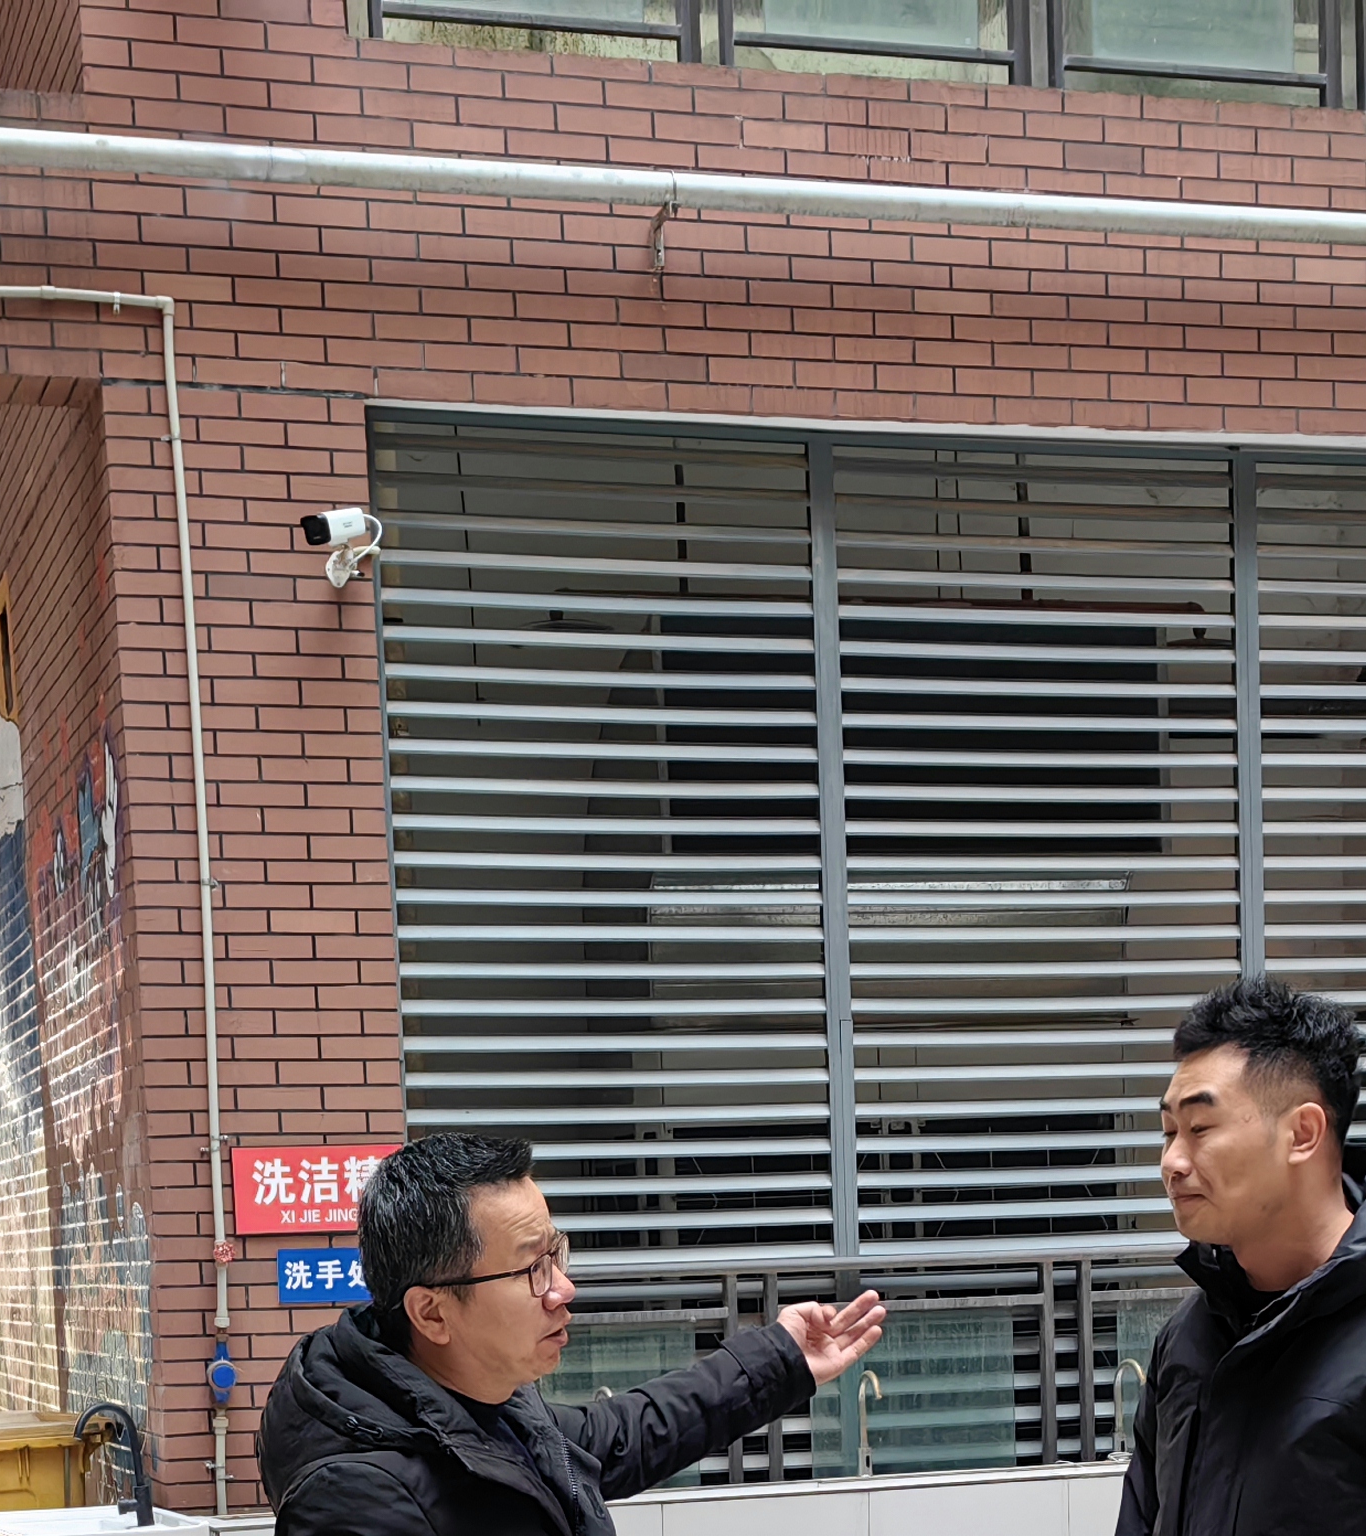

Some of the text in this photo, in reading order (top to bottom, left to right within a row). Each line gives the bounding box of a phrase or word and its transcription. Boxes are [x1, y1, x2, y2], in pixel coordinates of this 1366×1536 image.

[280, 1208, 358, 1224] XI JIE JING
